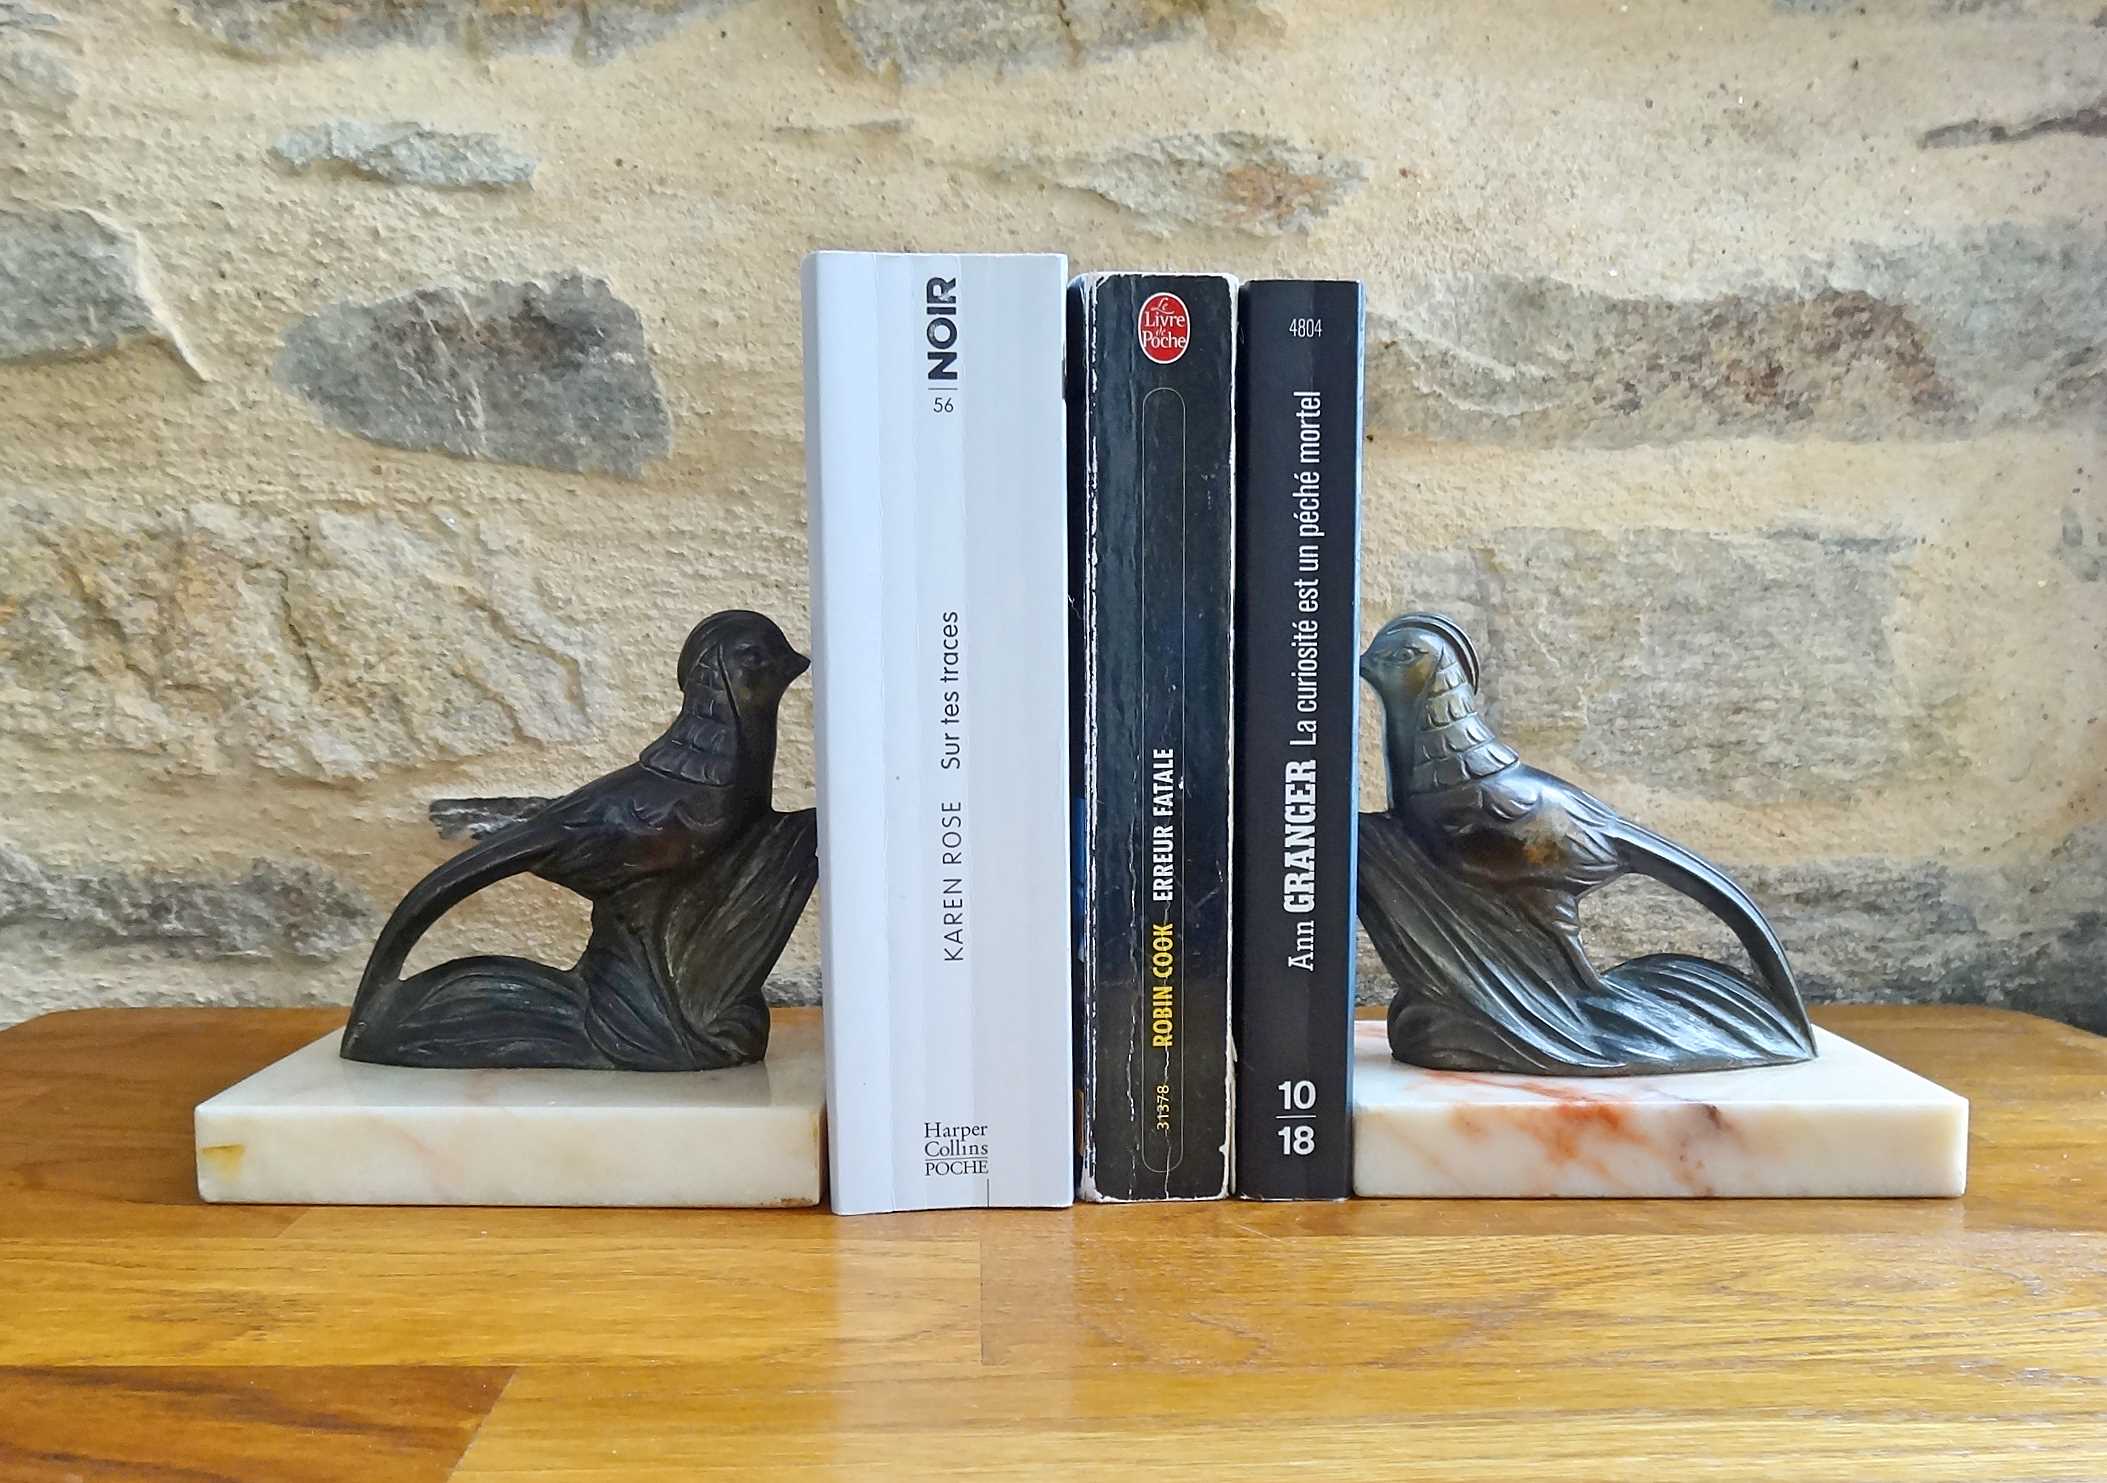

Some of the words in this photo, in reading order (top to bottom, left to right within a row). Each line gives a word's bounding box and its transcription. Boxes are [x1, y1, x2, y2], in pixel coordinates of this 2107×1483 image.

[1144, 311, 1186, 328] Livre
[1151, 297, 1175, 315] Le
[926, 276, 958, 380] NOIR
[1142, 330, 1187, 349] Poche
[1289, 318, 1322, 337] 4804
[933, 397, 954, 413] 56
[1293, 391, 1321, 463] mortel
[1292, 470, 1325, 537] péché
[1298, 544, 1319, 572] un
[1294, 578, 1319, 613] est
[940, 610, 958, 683] traces
[1291, 619, 1318, 713] curiosité
[940, 690, 960, 724] tes
[940, 732, 960, 769] Sur
[1289, 720, 1317, 745] La
[1152, 748, 1174, 817] FATALE
[941, 801, 962, 865] ROSE
[1283, 759, 1317, 913] GRANGER
[1152, 825, 1174, 901] ERREUR
[943, 878, 964, 962] KAREN
[1152, 923, 1174, 979] COOK
[1288, 920, 1314, 972] Ann
[1152, 986, 1174, 1047] ROBIN
[1156, 1084, 1170, 1131] 31378
[1278, 1080, 1317, 1110] 10
[924, 1121, 989, 1142] Harper
[924, 1139, 989, 1157] Collins
[1277, 1125, 1316, 1155] 18
[924, 1160, 989, 1176] POCHE
